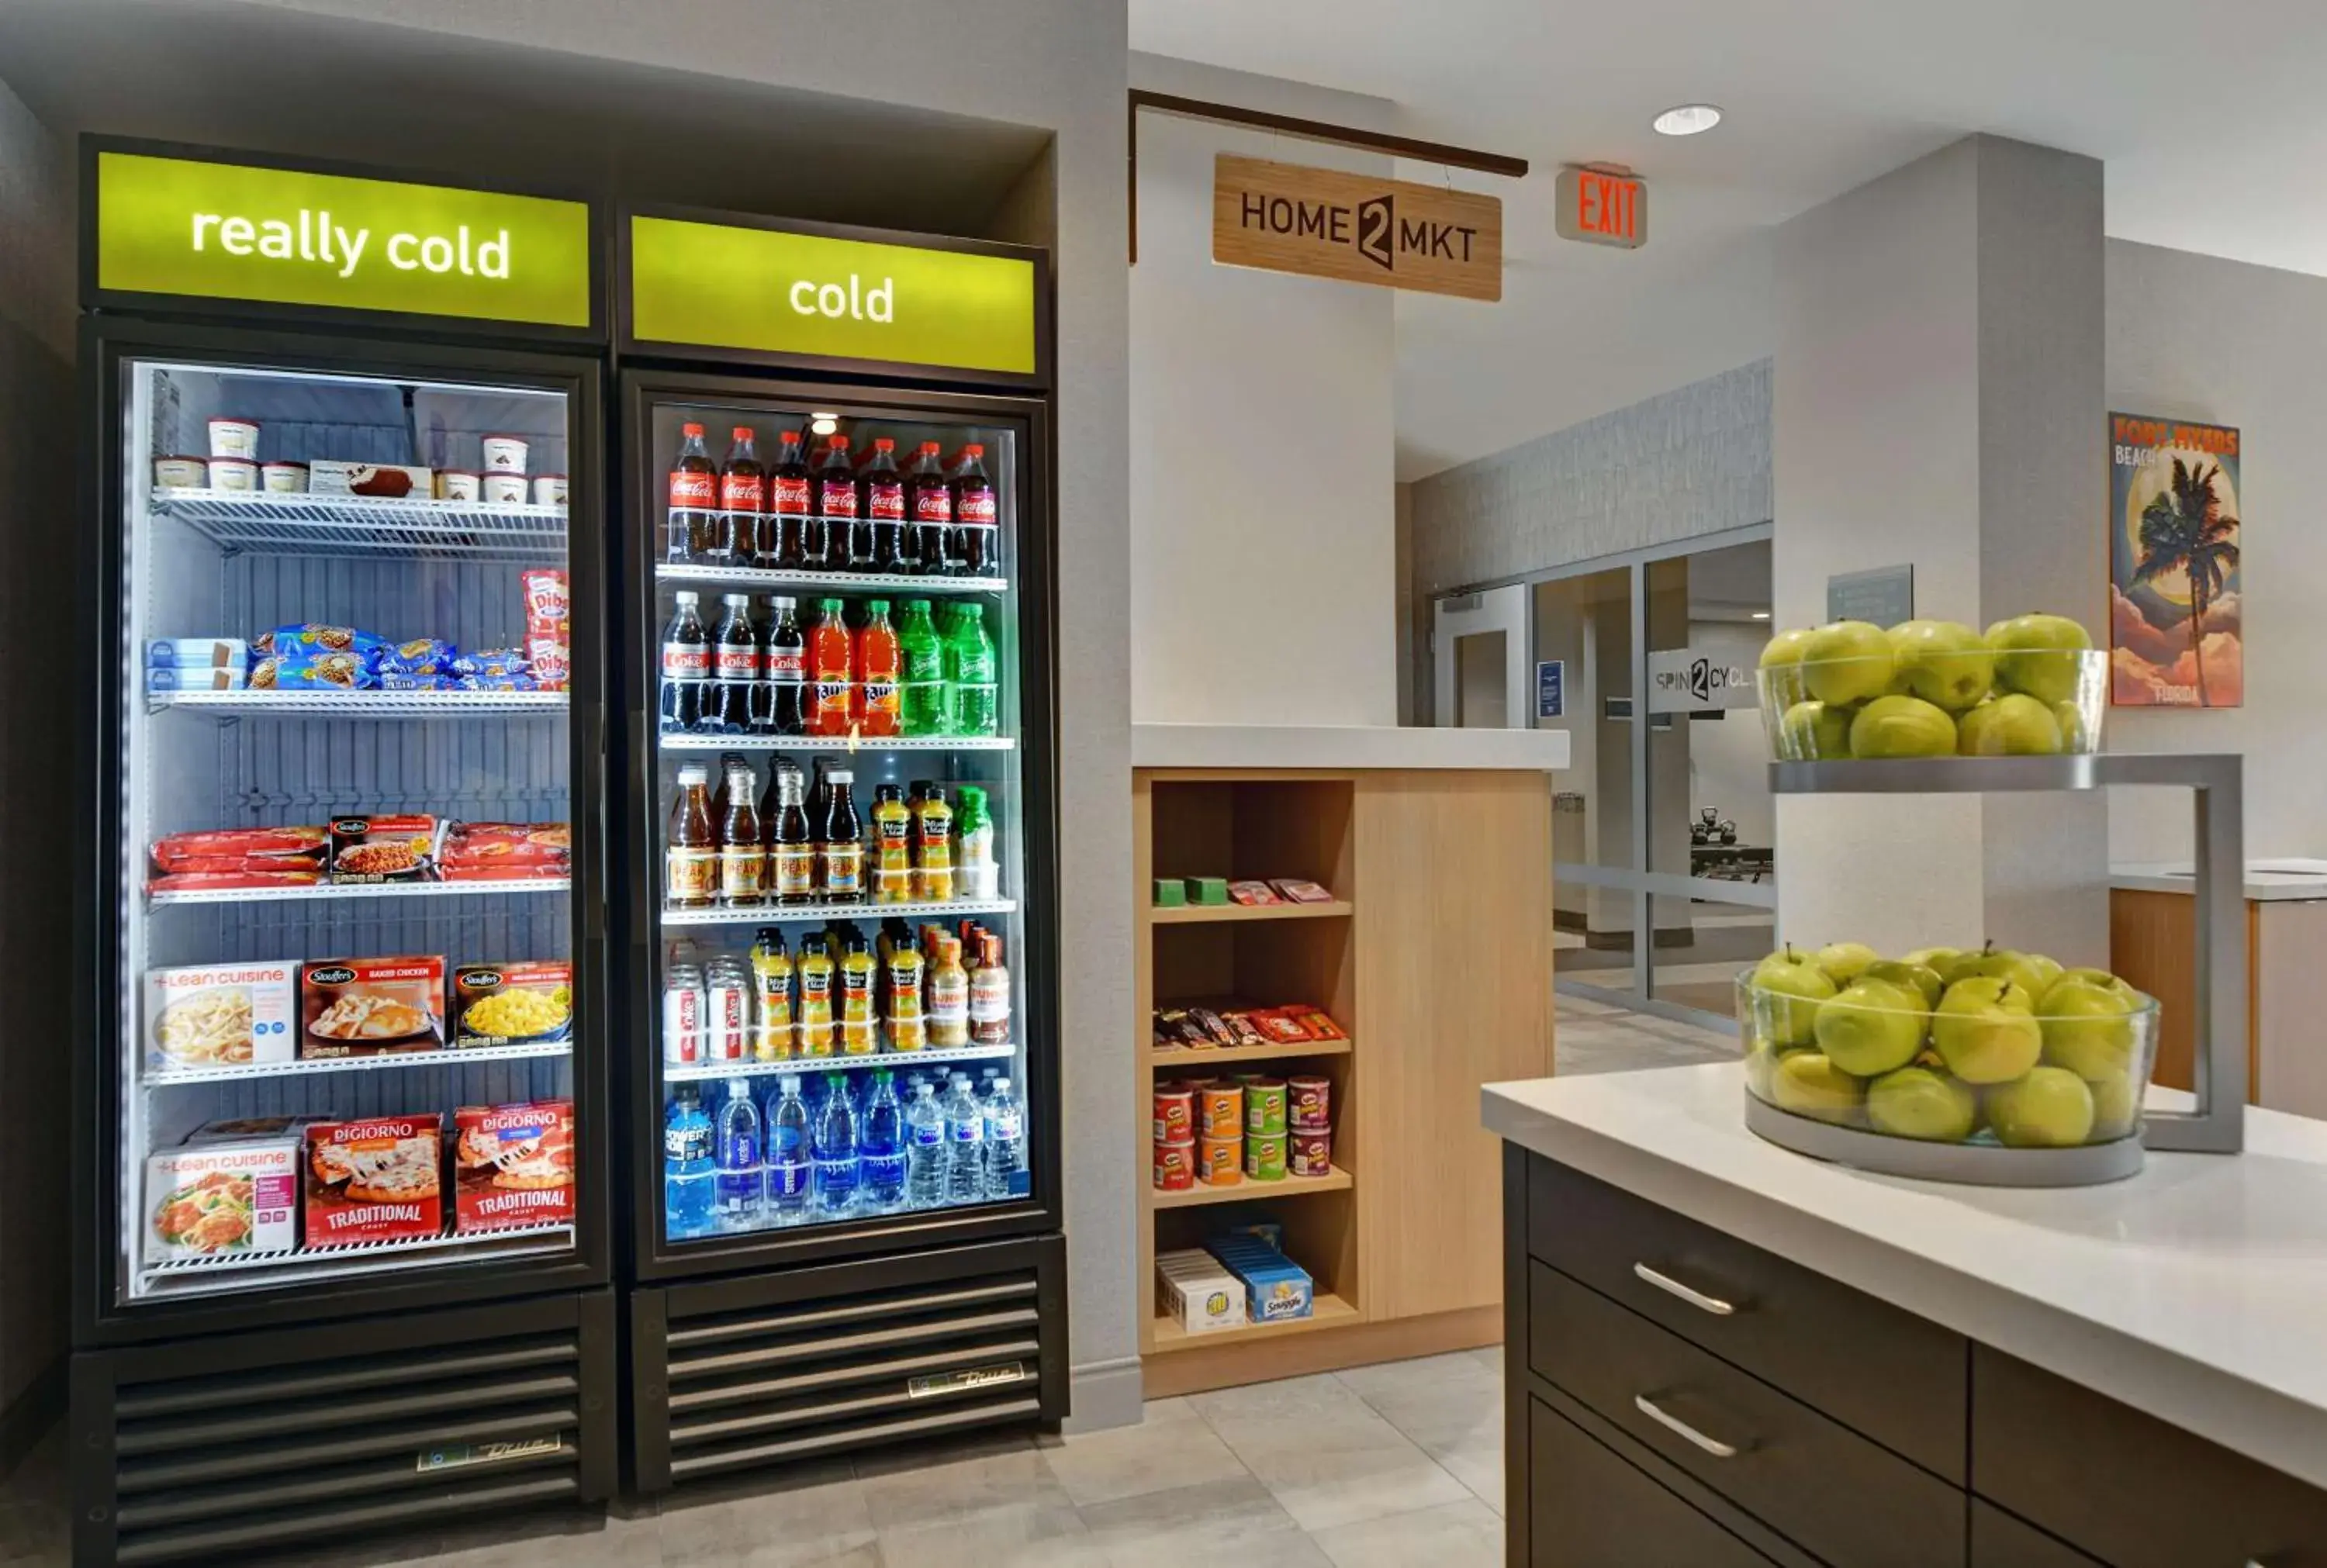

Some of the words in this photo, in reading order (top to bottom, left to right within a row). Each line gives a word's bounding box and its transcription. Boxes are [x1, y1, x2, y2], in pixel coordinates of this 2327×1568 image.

[1578, 171, 1637, 239] EXIT
[192, 209, 370, 279] really
[388, 226, 510, 279] cold
[790, 273, 894, 323] cold
[2173, 426, 2238, 456] MYERS
[2115, 445, 2157, 466] BEACH
[671, 654, 704, 668] Coke
[719, 654, 751, 668] Coke
[770, 657, 801, 669] Coke
[476, 1190, 566, 1215] TRADITIONAL
[327, 1204, 423, 1230] TRADITIONAL
[1267, 1296, 1302, 1313] Snuggle
